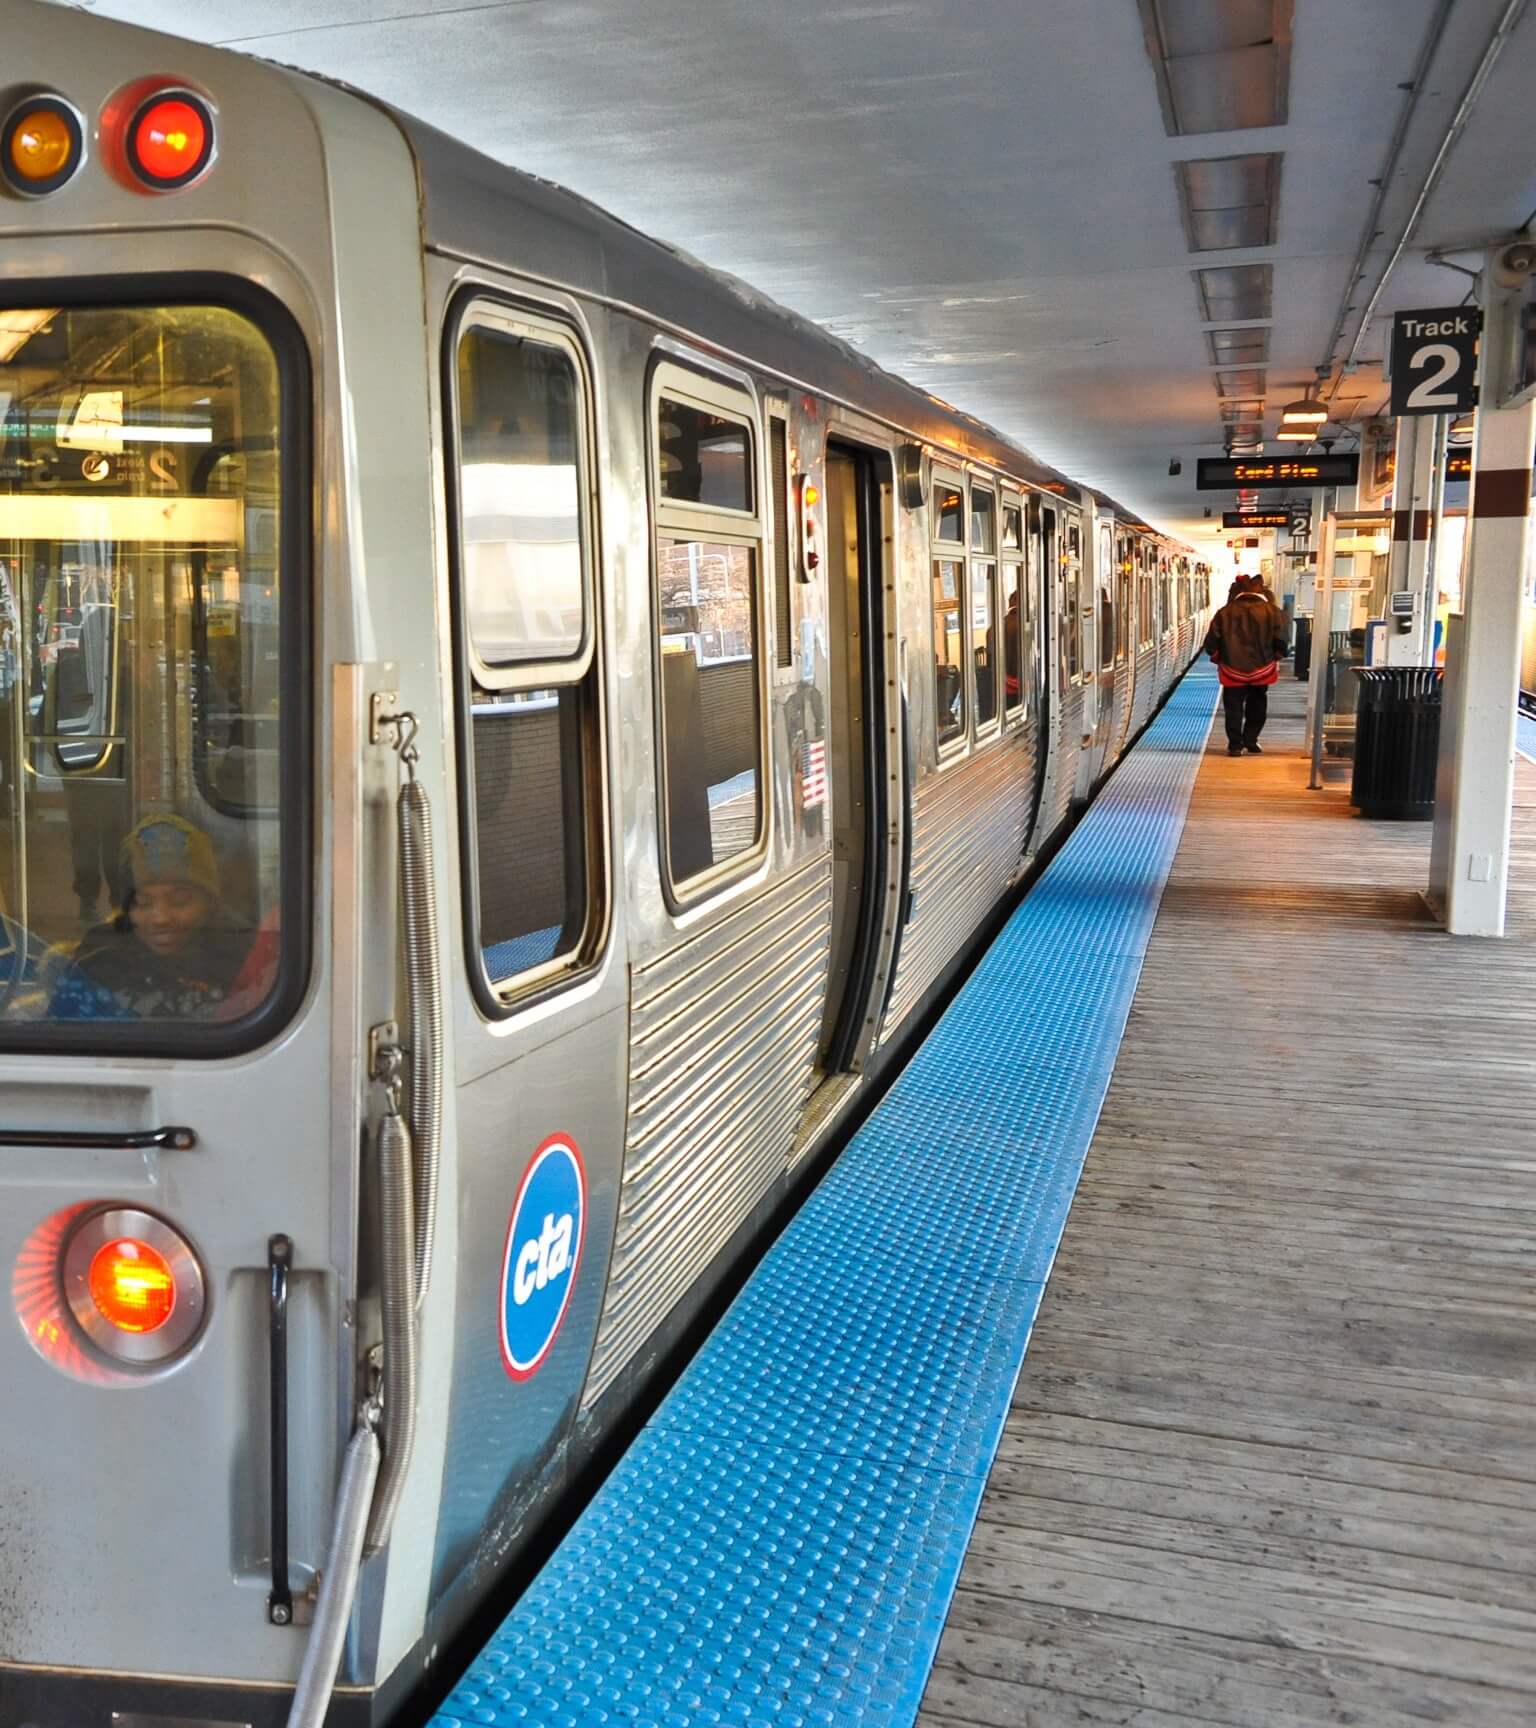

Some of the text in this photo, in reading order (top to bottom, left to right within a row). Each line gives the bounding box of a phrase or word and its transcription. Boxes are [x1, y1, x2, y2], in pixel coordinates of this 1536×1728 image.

[1401, 316, 1468, 338] Track
[1406, 343, 1461, 408] 2
[1292, 518, 1307, 535] 2
[514, 1212, 573, 1305] cta
